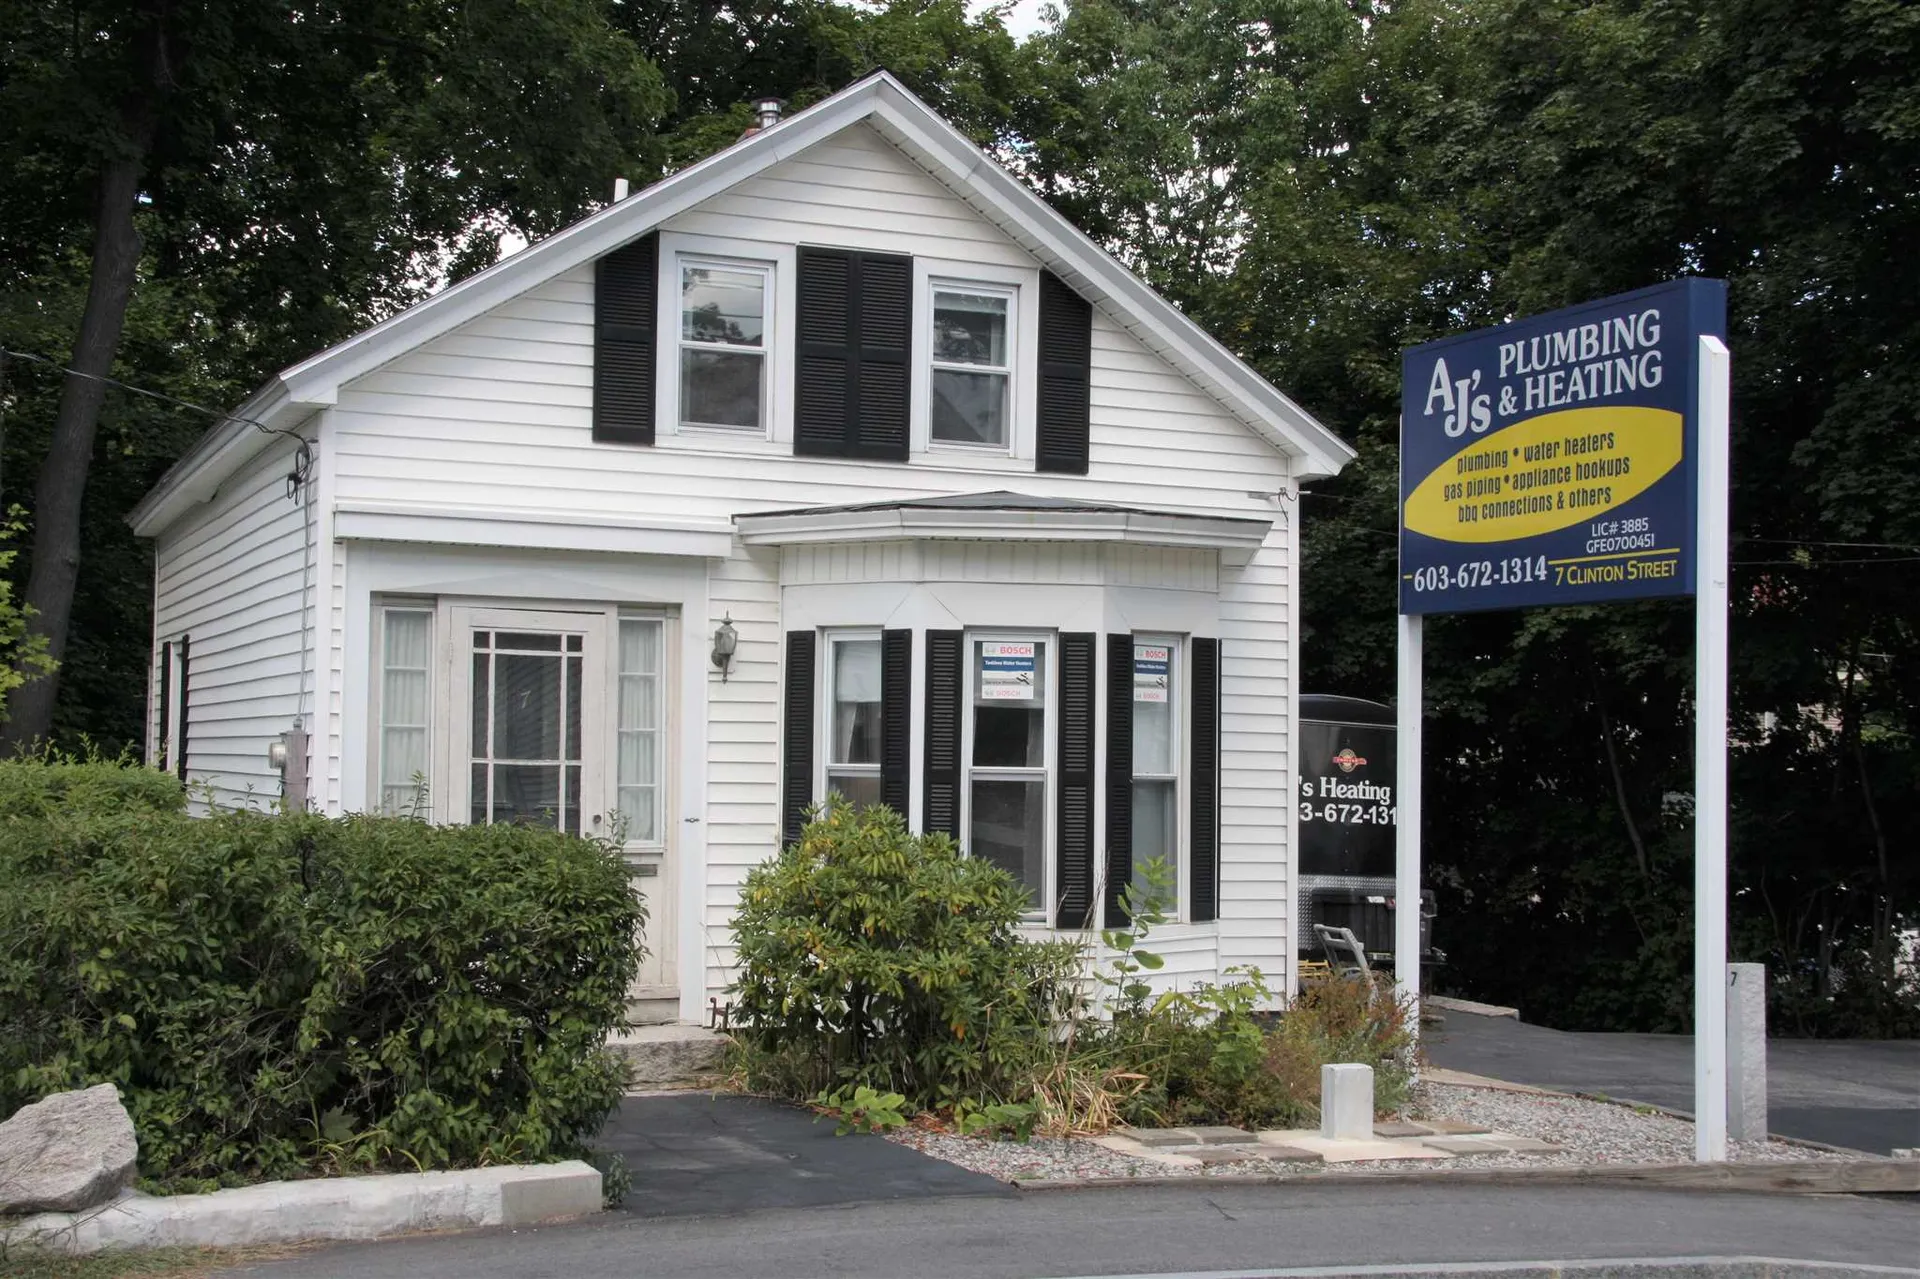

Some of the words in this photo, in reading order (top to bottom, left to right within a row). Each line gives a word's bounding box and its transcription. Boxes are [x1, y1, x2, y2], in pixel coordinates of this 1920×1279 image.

[1499, 309, 1661, 379] PLUMBING
[1423, 357, 1492, 438] AJ's
[1498, 385, 1518, 417] &
[1524, 350, 1663, 412] HEATING
[1457, 449, 1509, 475] plumbing
[1524, 439, 1560, 464] water
[1564, 432, 1615, 457] heaters
[1444, 483, 1463, 502] gas
[1466, 474, 1501, 499] piping
[1512, 465, 1572, 491] appliance
[1576, 456, 1631, 482] hookups
[1458, 504, 1478, 523] bbq
[1481, 494, 1553, 520] connections
[1556, 490, 1565, 511] &
[1569, 486, 1613, 509] others
[1591, 520, 1619, 537] LIC#
[1621, 516, 1649, 534] 3885
[1414, 555, 1549, 593] 603-672-1314
[1555, 568, 1565, 587] 7
[1567, 565, 1624, 585] CLINTON
[1627, 559, 1678, 580] STREET
[999, 646, 1032, 655] BOSCH
[1144, 650, 1167, 659] BOSCH
[1320, 776, 1391, 806] Heating
[1730, 971, 1738, 987] 7
